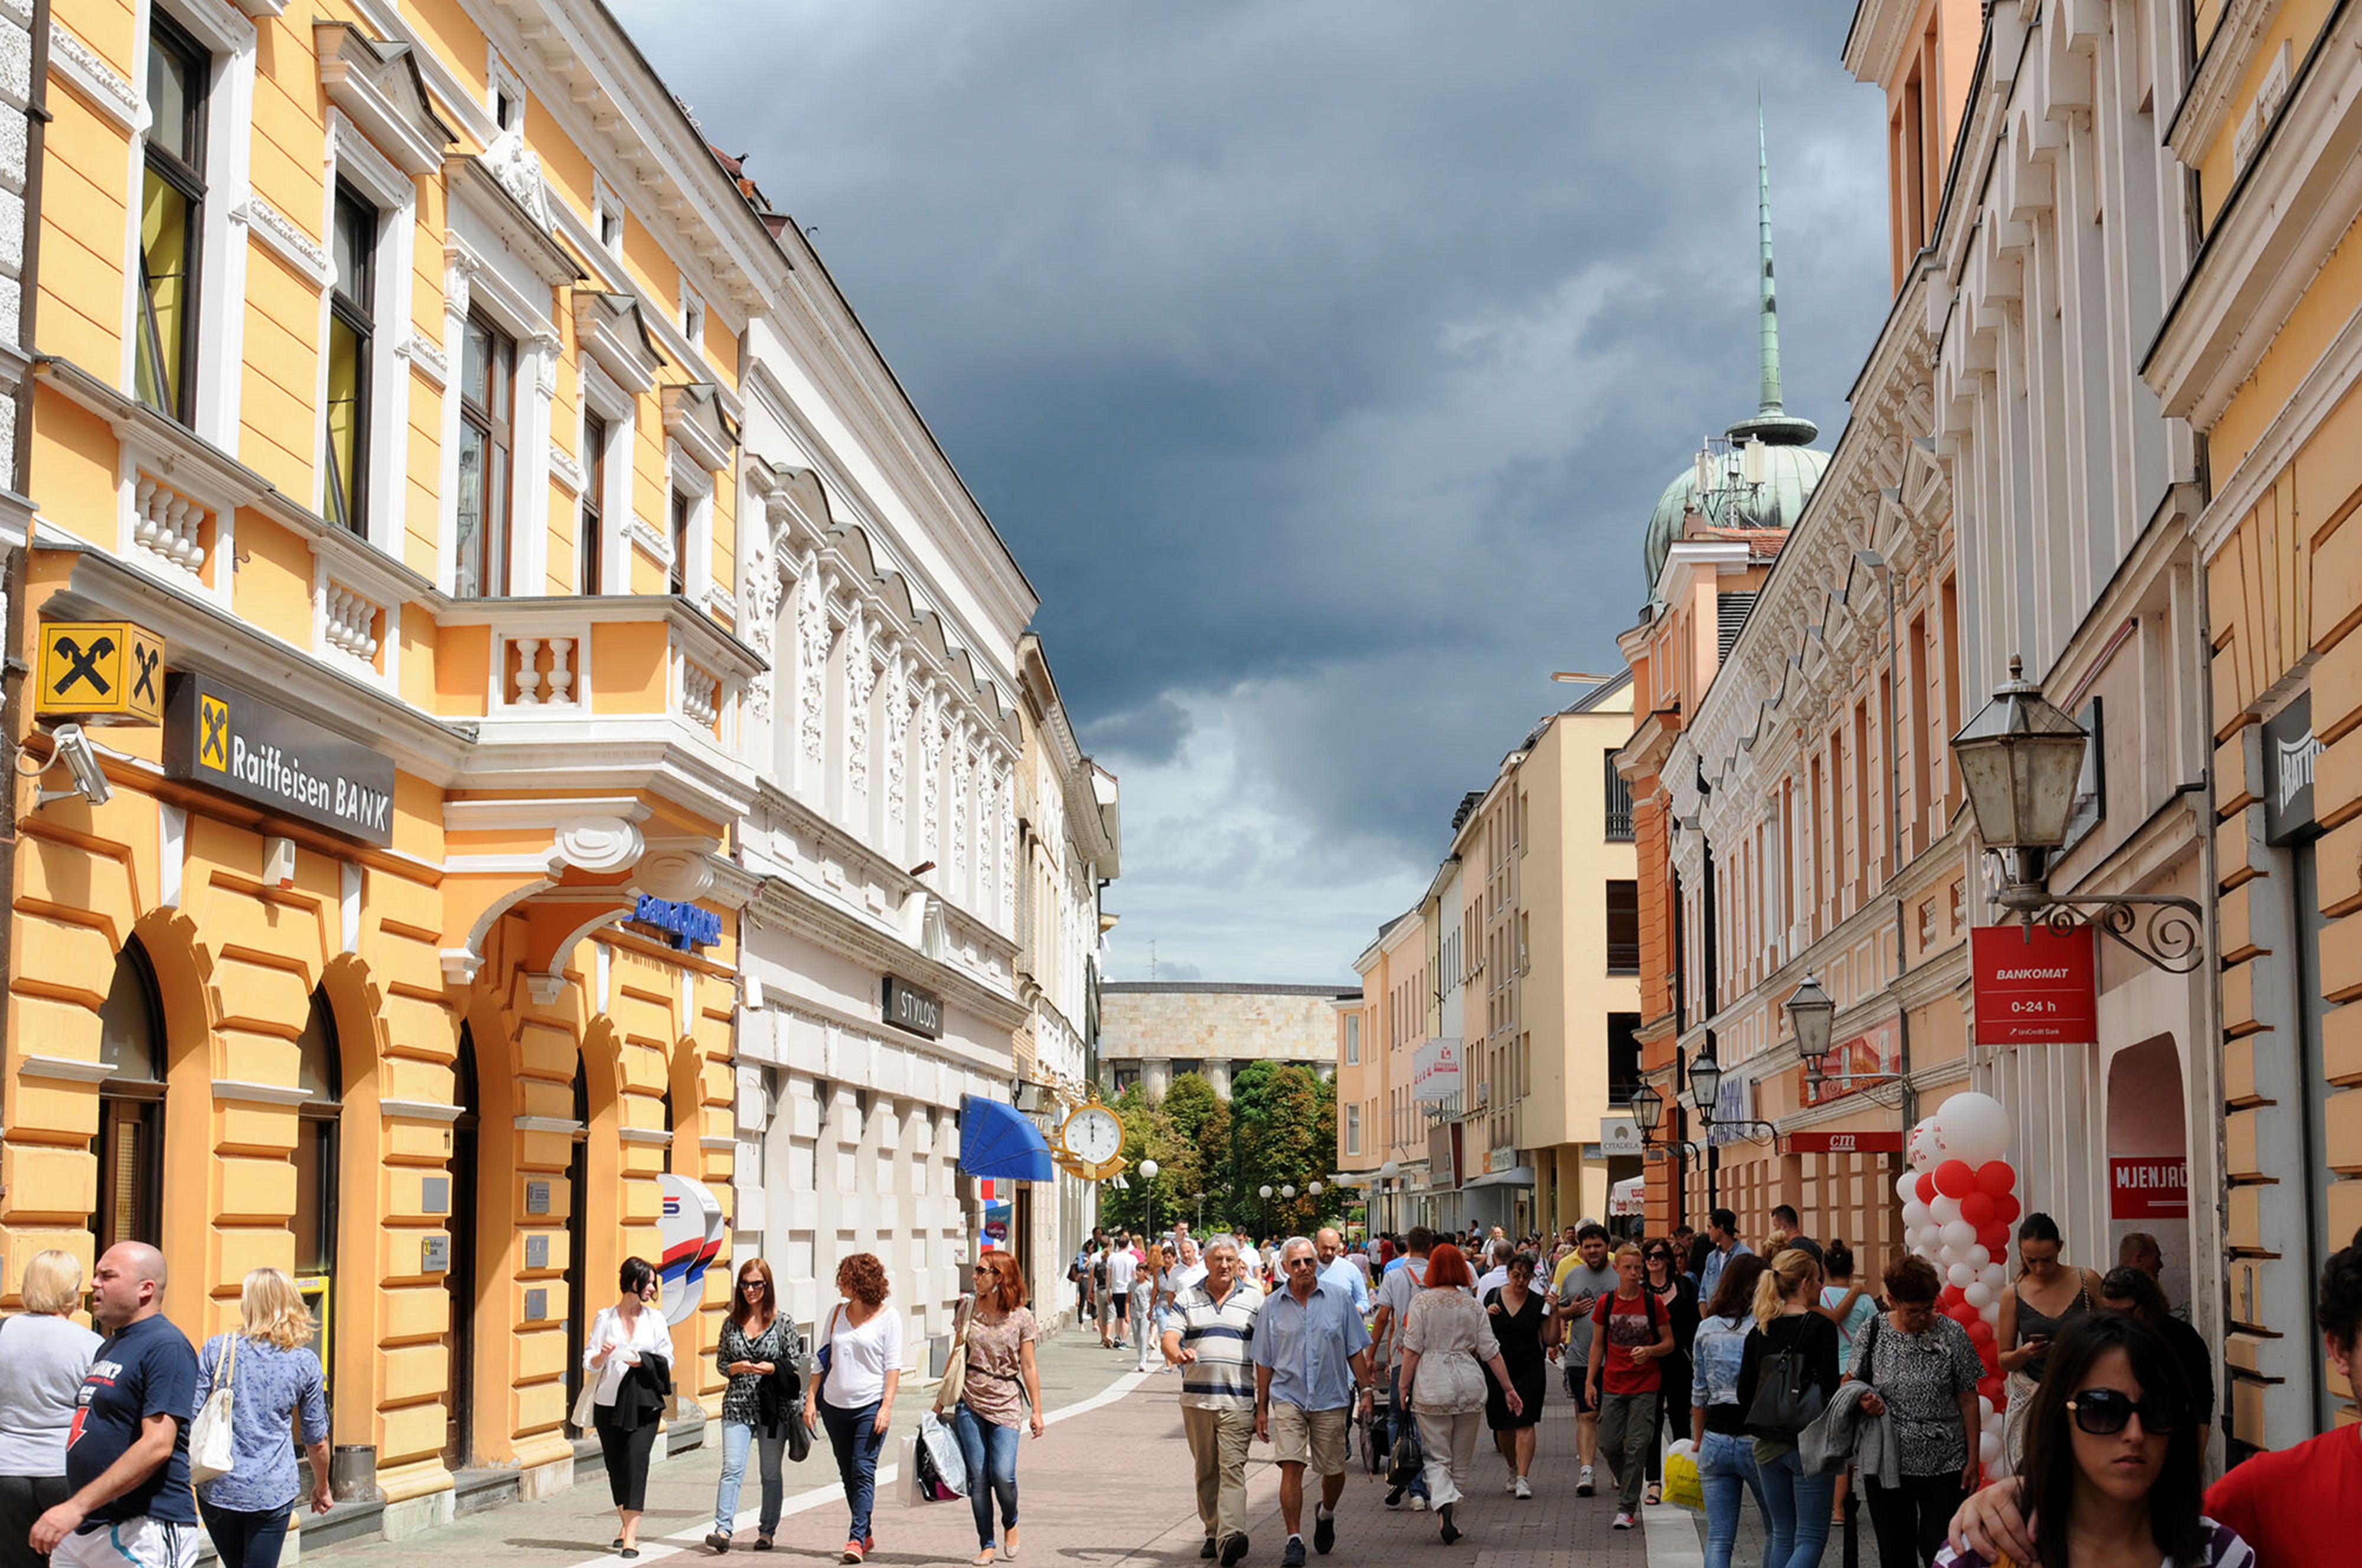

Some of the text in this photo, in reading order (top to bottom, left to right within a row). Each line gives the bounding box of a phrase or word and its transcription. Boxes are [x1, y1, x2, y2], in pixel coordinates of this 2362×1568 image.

[233, 735, 389, 832] Raiffeisen BANK
[1996, 969, 2069, 980] BANKOMAT
[901, 991, 936, 1029] STYLOS
[2011, 1001, 2056, 1012] 0-24 h
